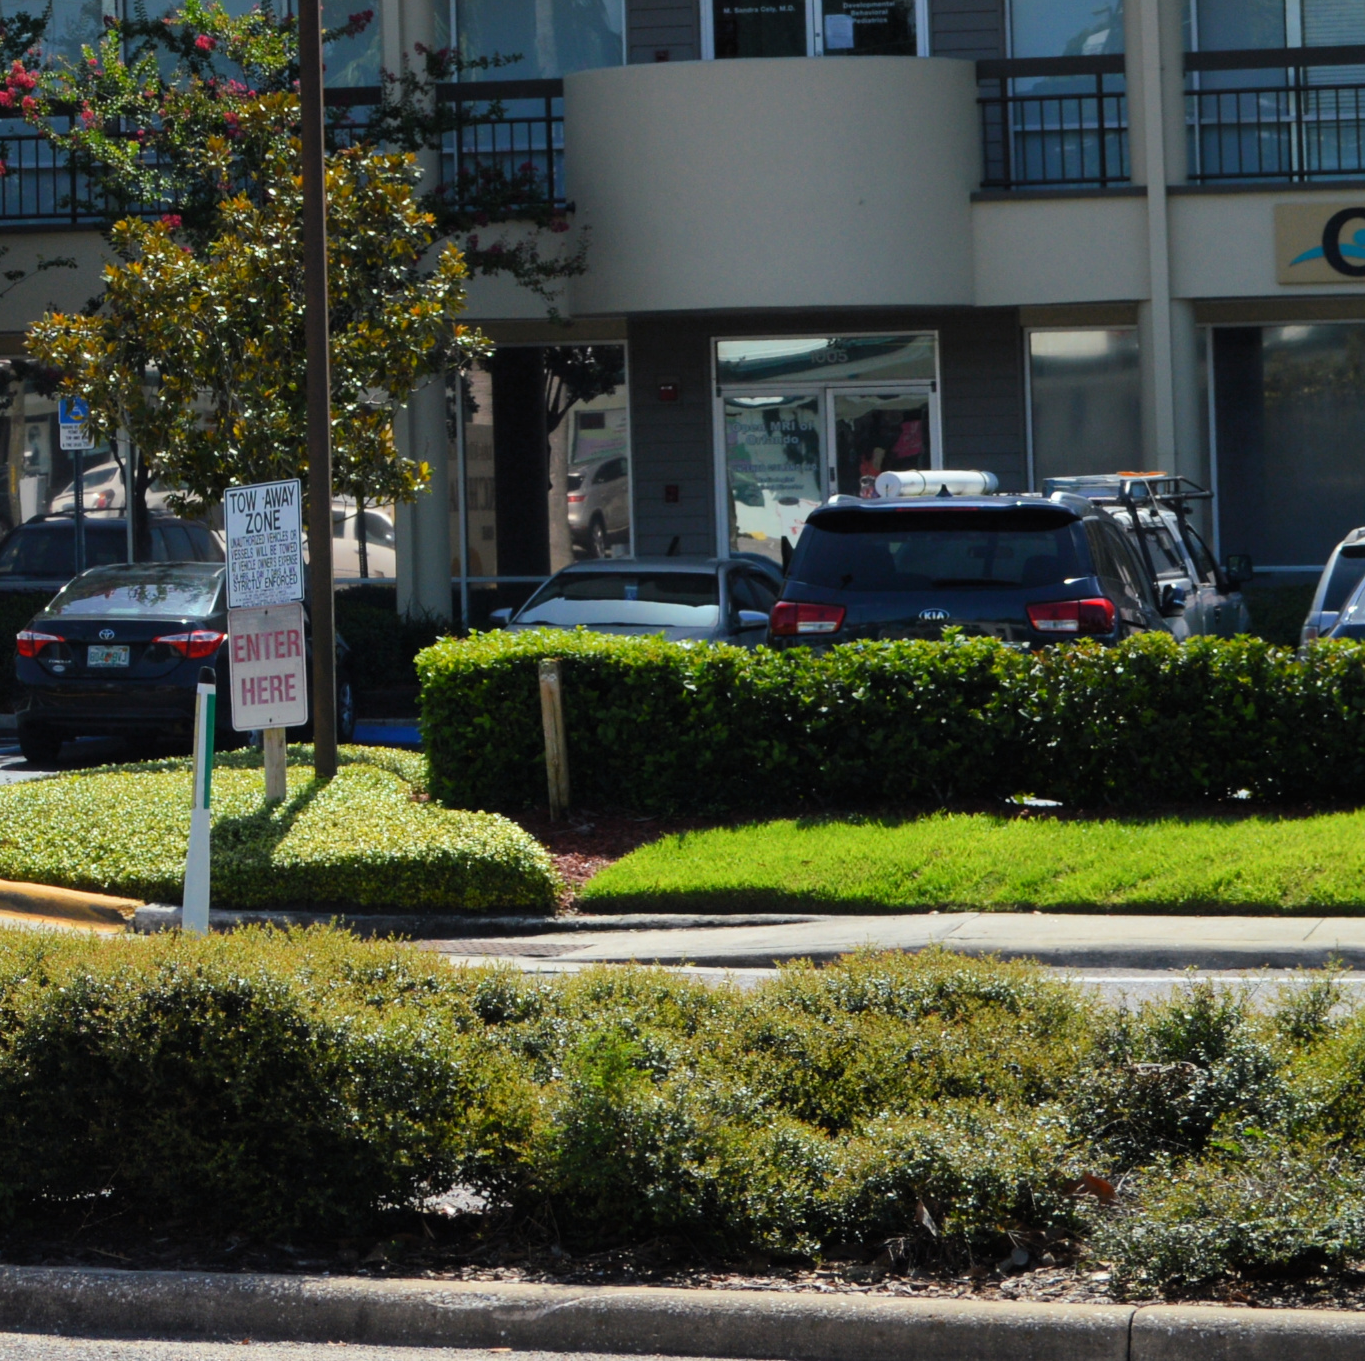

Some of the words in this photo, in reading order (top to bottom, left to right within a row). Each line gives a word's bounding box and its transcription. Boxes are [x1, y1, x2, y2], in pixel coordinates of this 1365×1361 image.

[770, 421, 795, 431] MRI
[229, 490, 257, 514] TOW
[264, 484, 295, 509] AWAY
[245, 509, 281, 534] ZONE
[233, 578, 262, 592] STRICTLY
[264, 574, 298, 588] ENFORCED
[924, 611, 945, 620] KIA
[233, 629, 301, 664] ENTER
[241, 673, 297, 706] HERE
